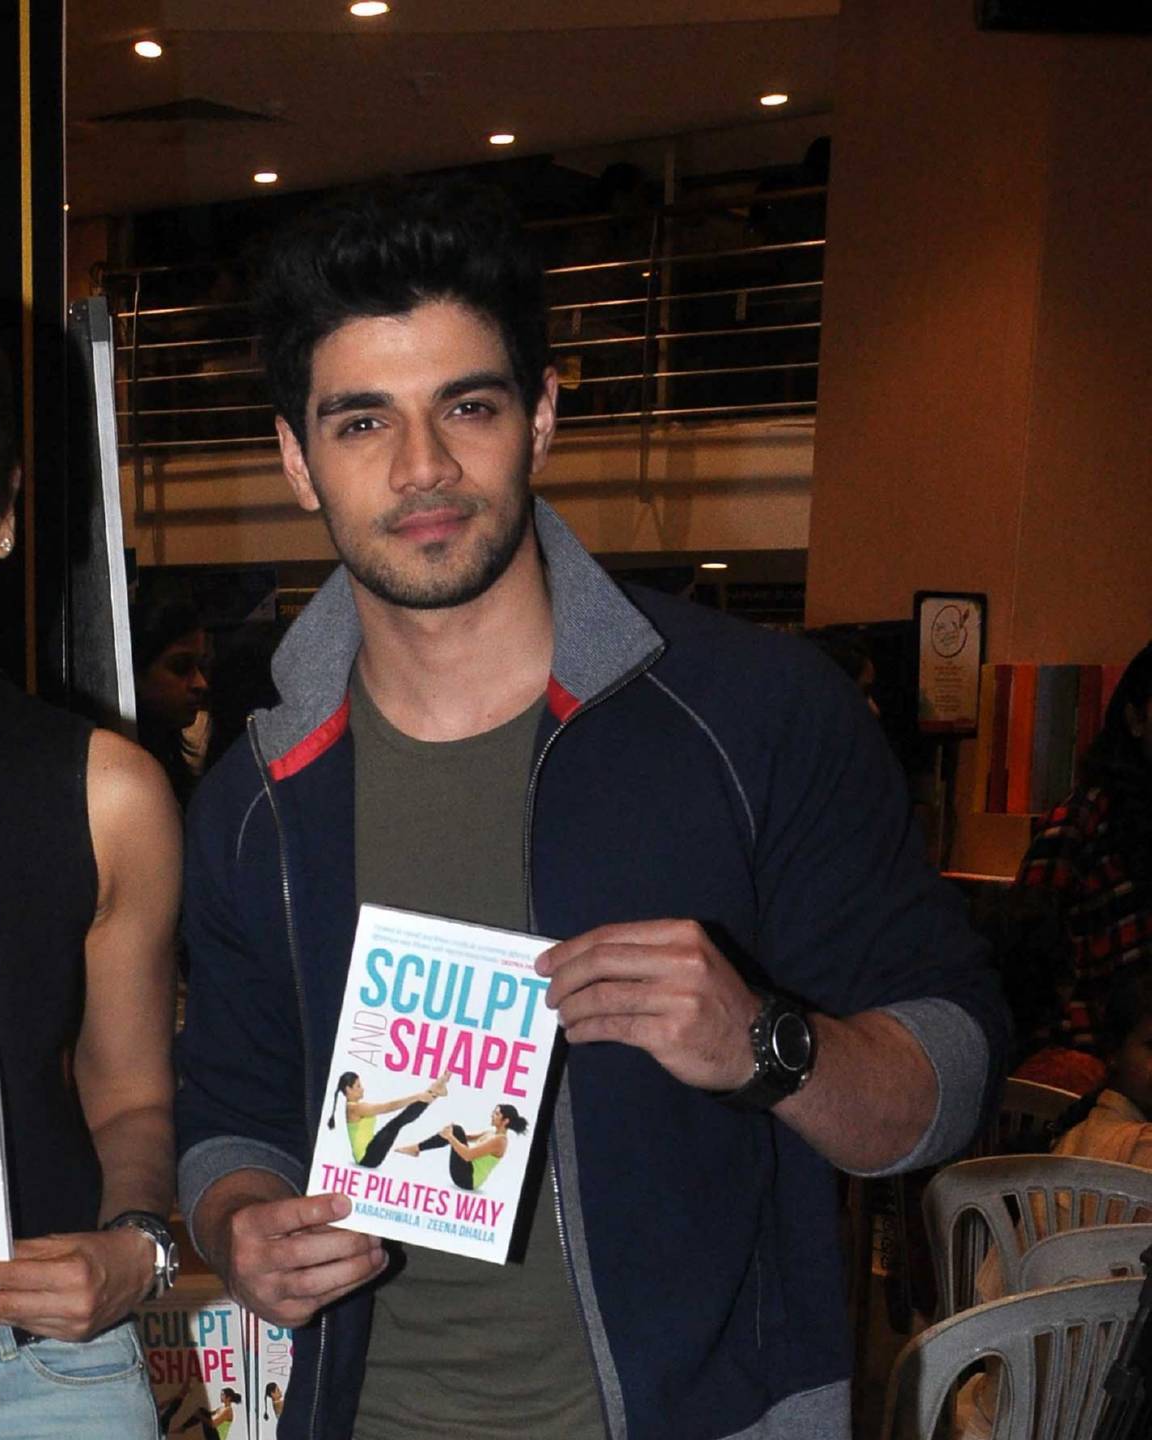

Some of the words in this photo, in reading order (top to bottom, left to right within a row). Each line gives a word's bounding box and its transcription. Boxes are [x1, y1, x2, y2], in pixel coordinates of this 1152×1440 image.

[359, 947, 551, 1039] SCULPT
[348, 1010, 388, 1067] AND
[384, 1017, 537, 1098] SHAPE
[321, 1164, 363, 1198] THE
[364, 1173, 451, 1216] PILATES
[454, 1193, 505, 1228] WAY
[149, 1348, 237, 1385] SHAPE
[266, 1343, 289, 1377] AND
